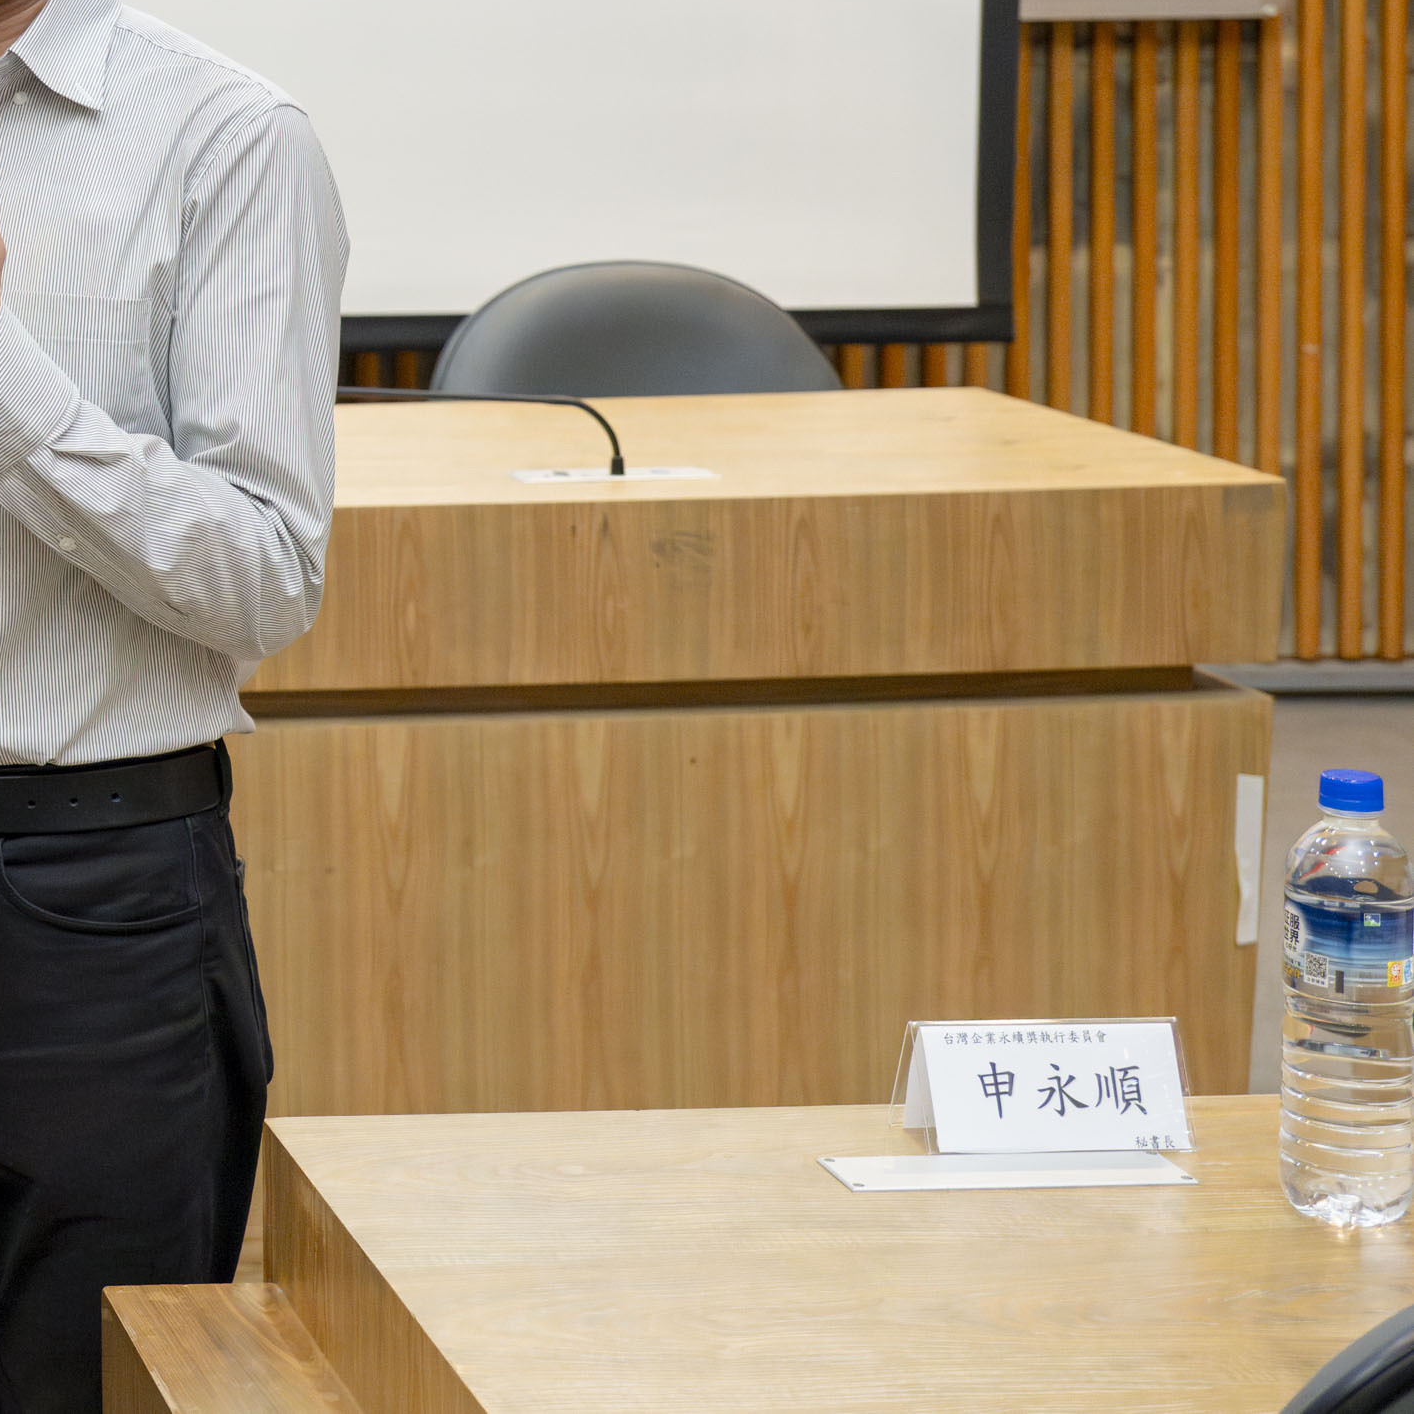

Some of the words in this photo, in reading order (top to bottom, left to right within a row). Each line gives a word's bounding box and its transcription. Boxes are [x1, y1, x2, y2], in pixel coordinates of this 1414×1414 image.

[977, 1061, 1147, 1119] 申永順
[1135, 1135, 1176, 1149] 秘書長
